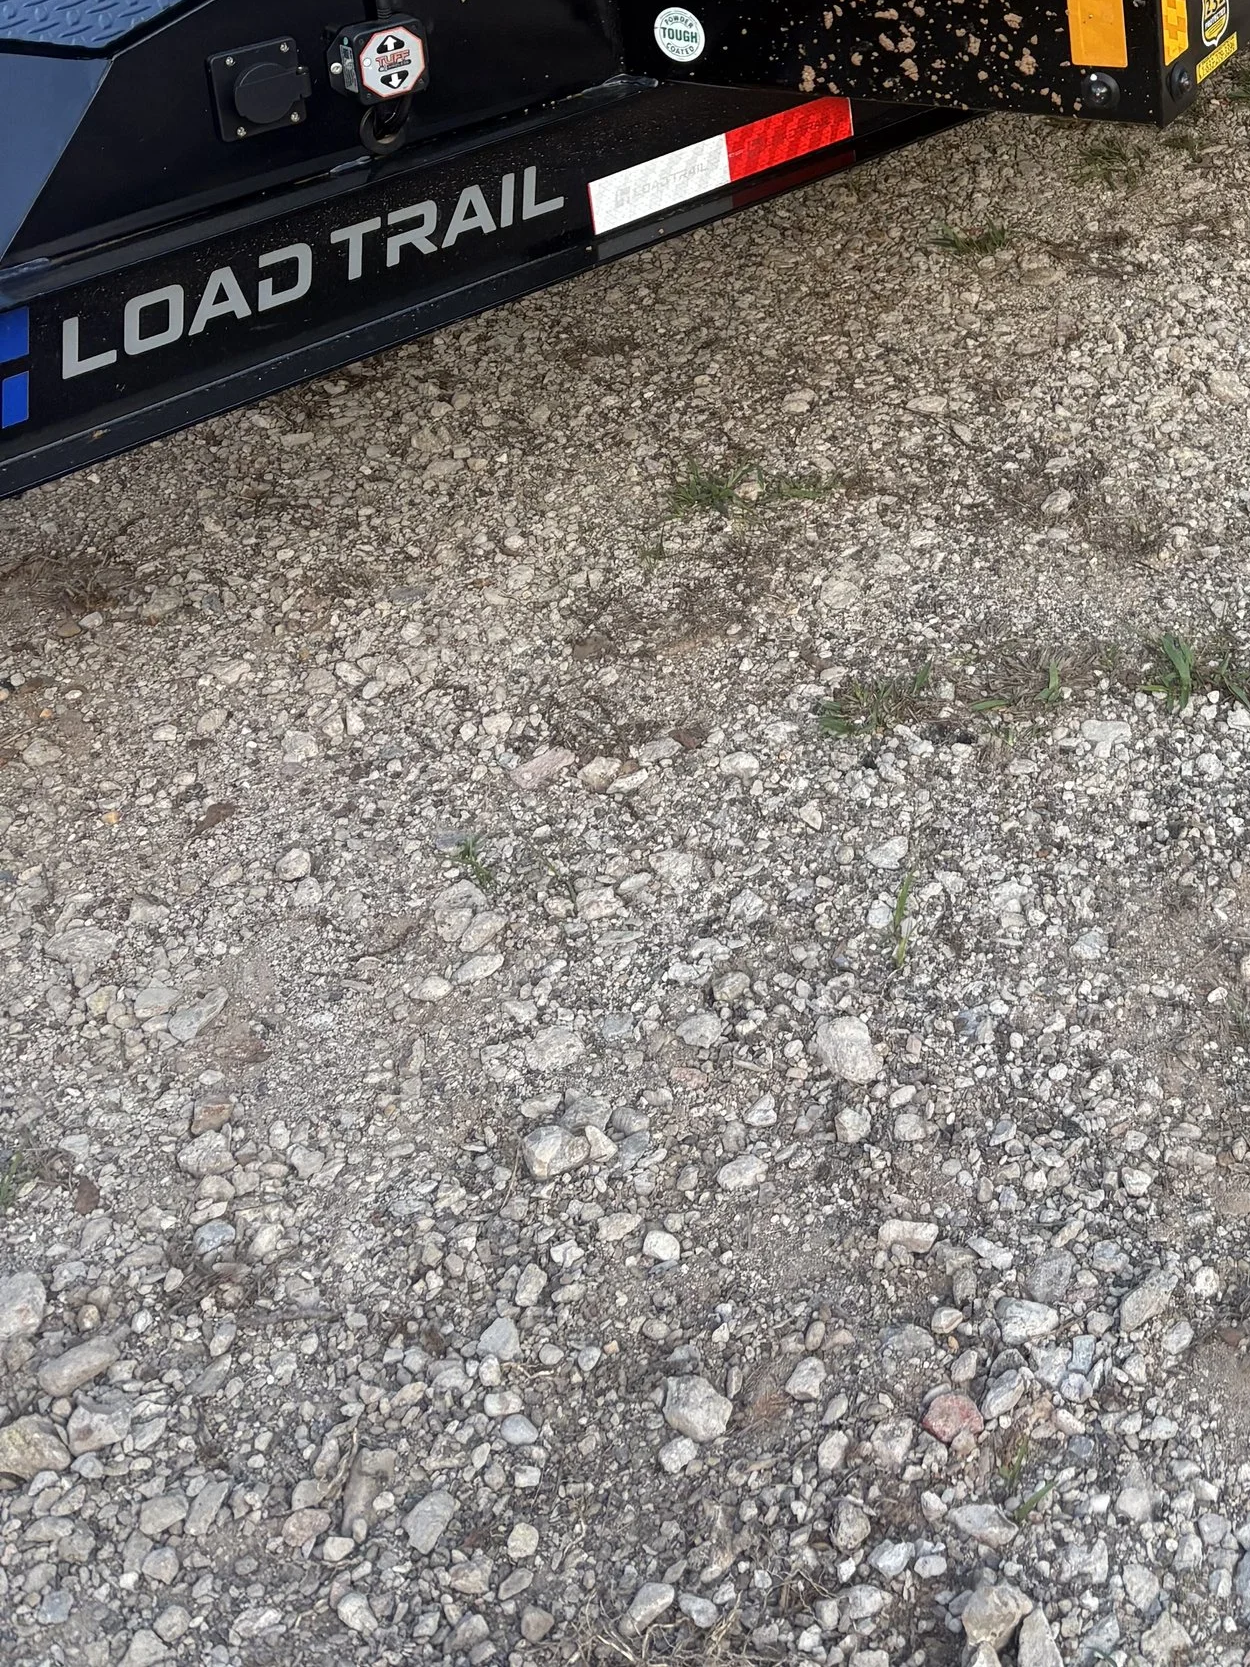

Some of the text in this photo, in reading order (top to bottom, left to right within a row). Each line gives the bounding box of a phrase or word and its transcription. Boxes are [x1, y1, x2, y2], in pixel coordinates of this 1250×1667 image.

[664, 15, 694, 29] POWDER
[660, 27, 698, 44] TOUGH
[666, 42, 694, 55] COATED
[375, 49, 410, 67] TUFF
[62, 166, 565, 380] LOAD TRAIL
